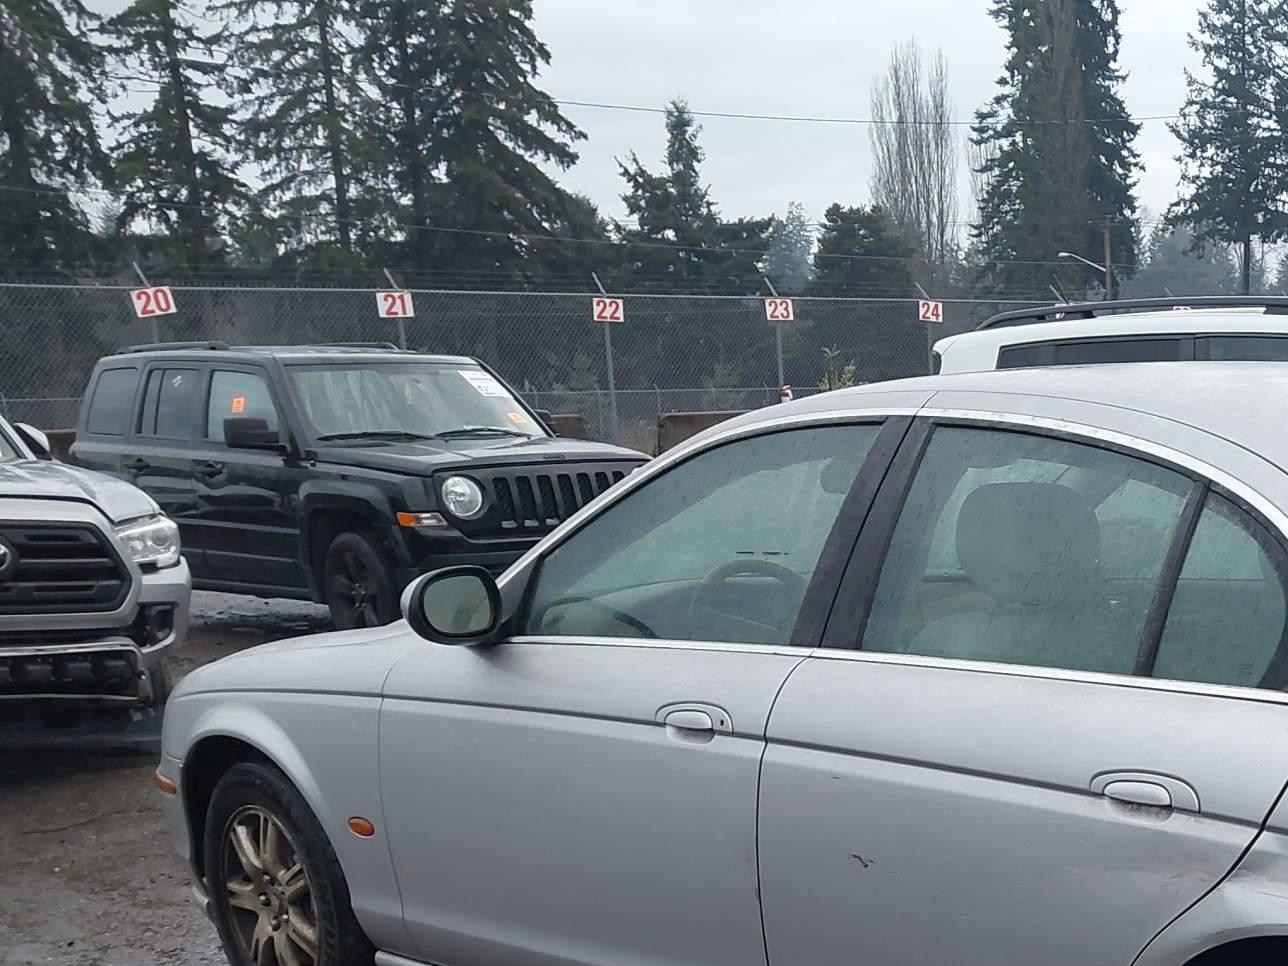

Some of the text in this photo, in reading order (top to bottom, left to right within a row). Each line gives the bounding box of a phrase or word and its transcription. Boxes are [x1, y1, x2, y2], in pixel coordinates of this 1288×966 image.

[137, 289, 171, 315] 20
[384, 293, 408, 317] 21
[596, 300, 621, 321] 22
[768, 299, 791, 320] 23
[921, 301, 941, 321] 24
